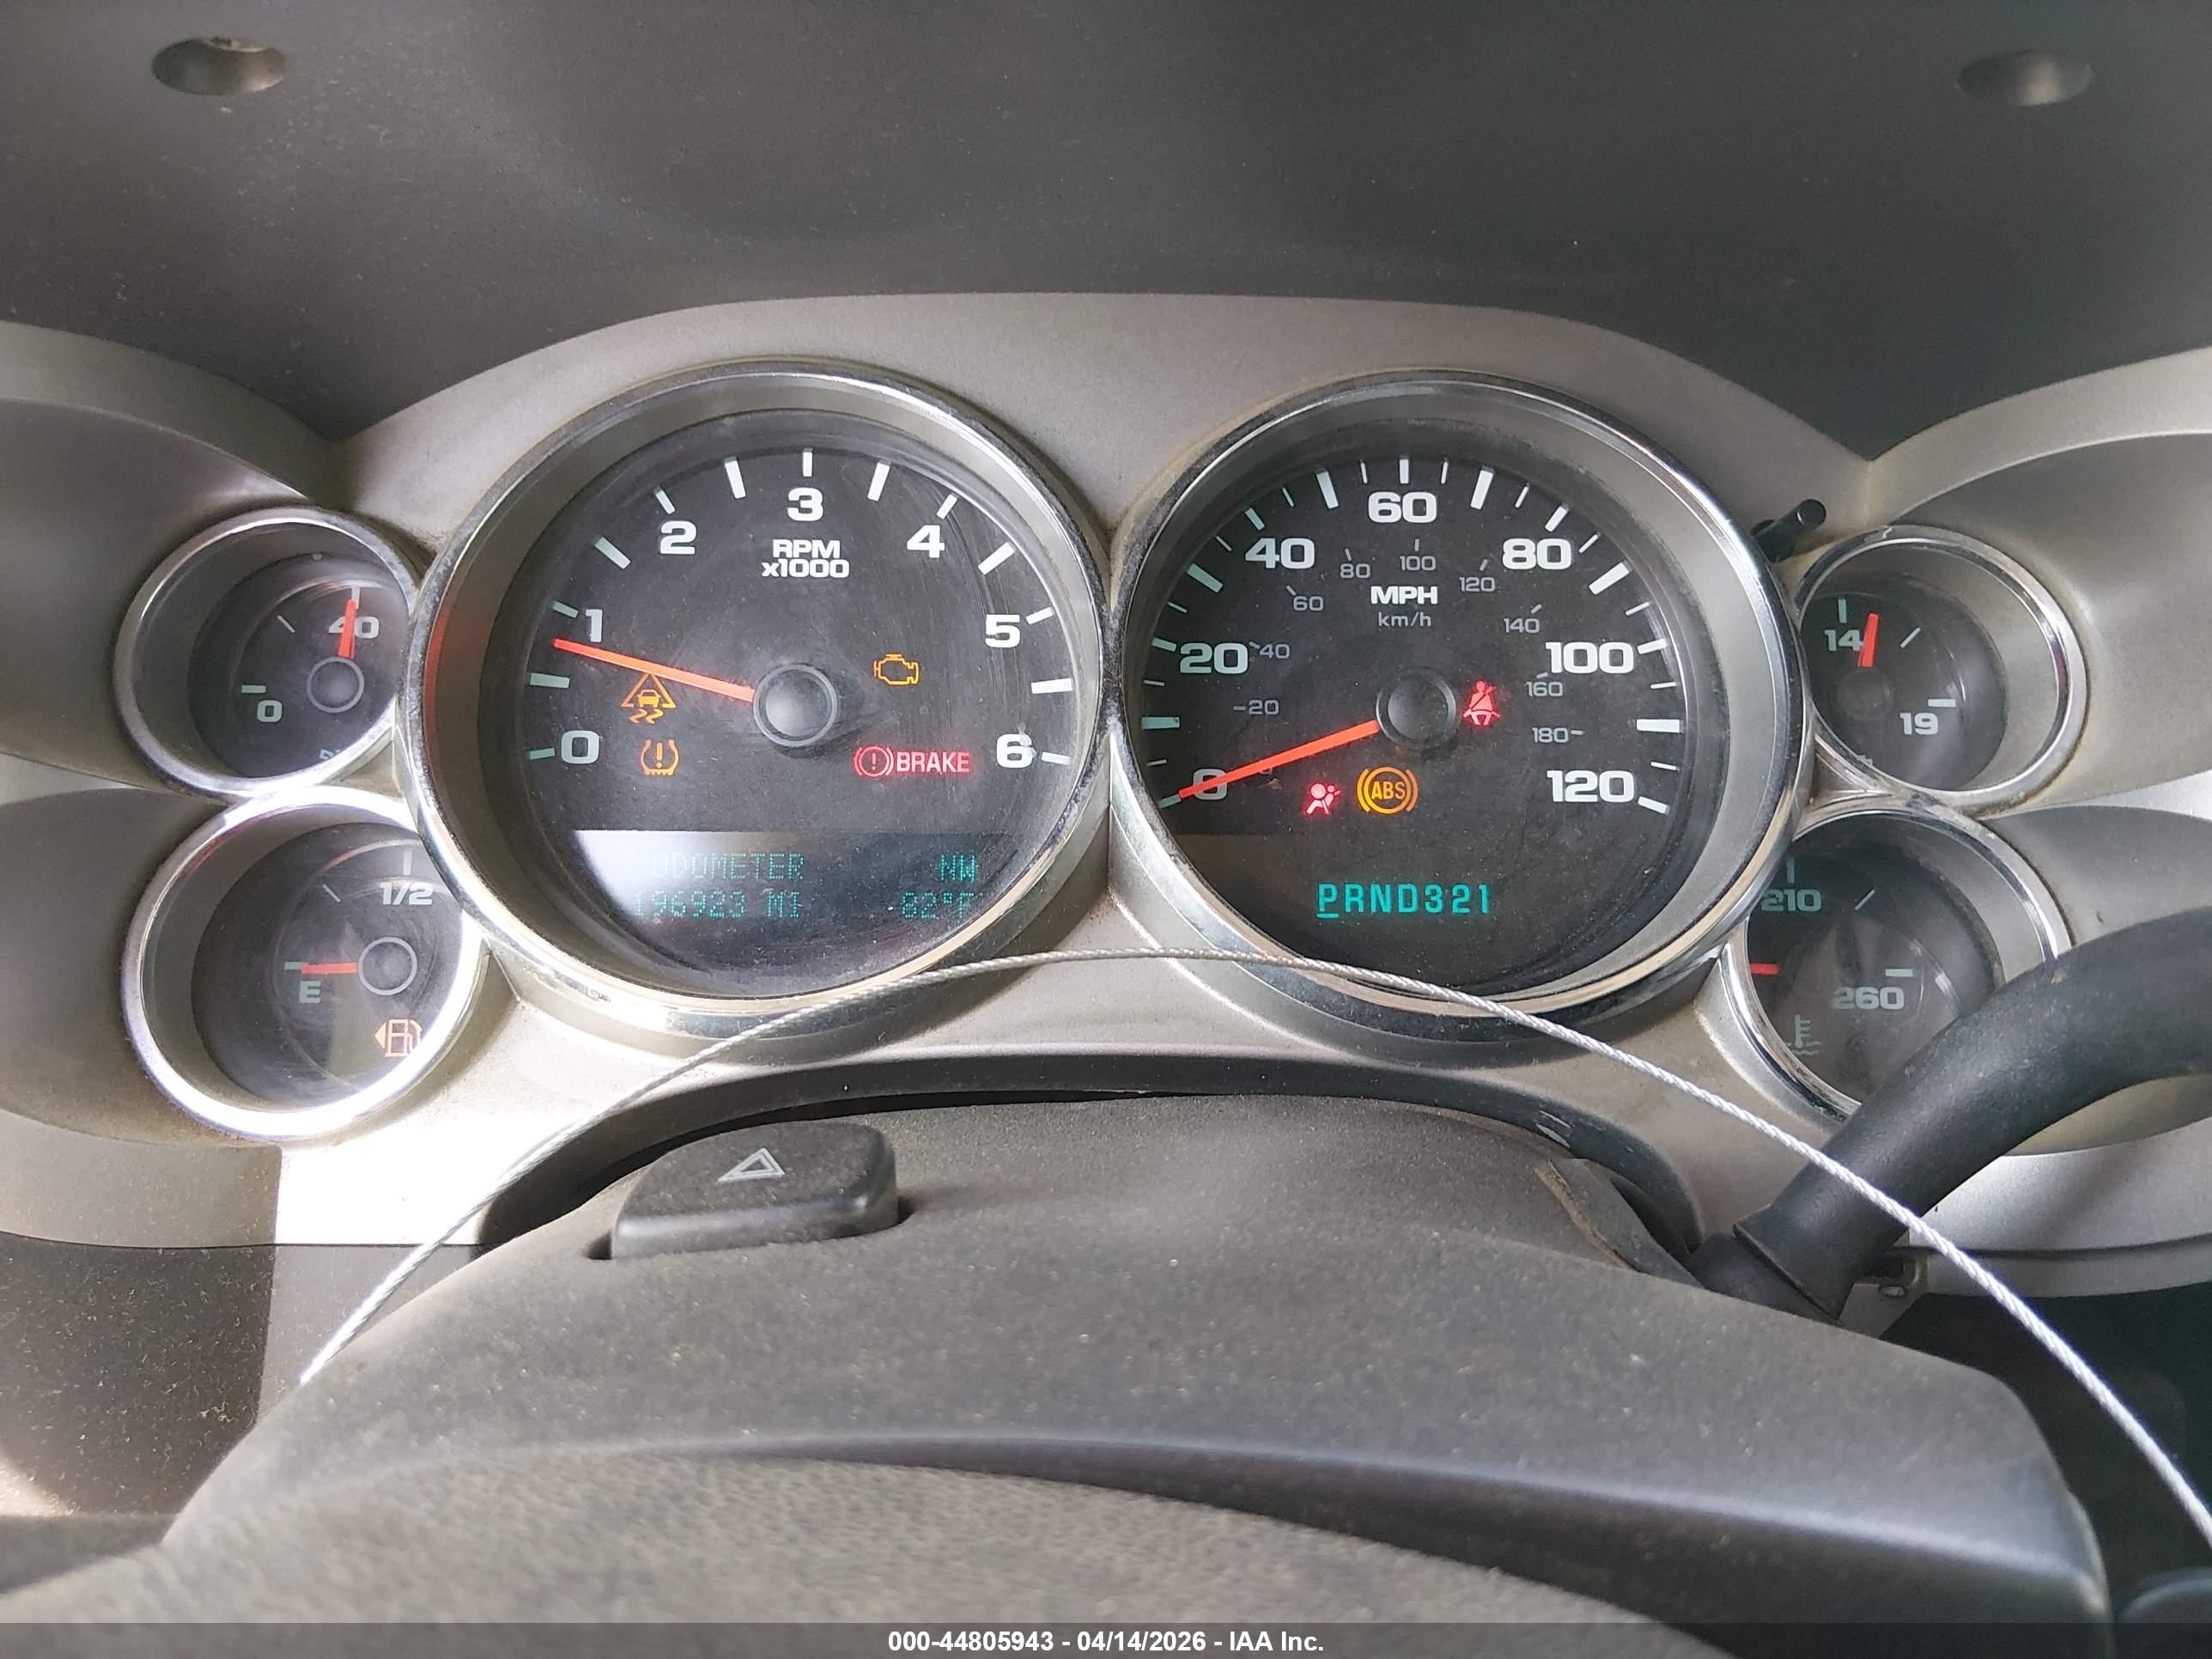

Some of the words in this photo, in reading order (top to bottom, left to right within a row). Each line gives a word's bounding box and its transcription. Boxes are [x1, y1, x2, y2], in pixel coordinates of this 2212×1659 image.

[787, 486, 824, 522] 3
[1367, 491, 1438, 524] 60
[659, 520, 697, 556] 2
[772, 538, 841, 559] RPM
[907, 525, 945, 558] 4
[1244, 538, 1316, 569] 40
[1399, 556, 1437, 571] 100
[1502, 538, 1572, 571] 80
[761, 560, 850, 579] x1000
[1339, 562, 1371, 580] 80
[1370, 586, 1439, 605] MPH
[1459, 577, 1496, 592] 120
[1291, 595, 1324, 612] 60
[585, 608, 603, 642] 1
[984, 614, 1021, 649] 5
[1376, 611, 1431, 628] km/h
[1503, 617, 1540, 634] 140
[1258, 644, 1291, 659] 40
[1824, 629, 1864, 652] 14
[1179, 642, 1249, 675] 20
[1545, 641, 1635, 674] 100
[1526, 681, 1564, 697] 160
[256, 700, 283, 723] 0
[1249, 699, 1279, 715] 20
[1532, 726, 1569, 743] 180
[1899, 712, 1939, 735] 19
[560, 729, 599, 765] 0
[995, 732, 1036, 769] 6
[896, 750, 970, 774] BRAKE
[1193, 769, 1228, 800] 0
[1371, 781, 1406, 799] ABS
[1547, 769, 1635, 803] 120
[653, 852, 805, 880] ODOMETER
[941, 854, 975, 882] NW
[380, 882, 433, 906] 1/2
[633, 890, 745, 919] 196923
[767, 890, 801, 919] MI
[1760, 889, 1822, 912] 210
[298, 981, 321, 1004] E
[1832, 986, 1905, 1010] 260
